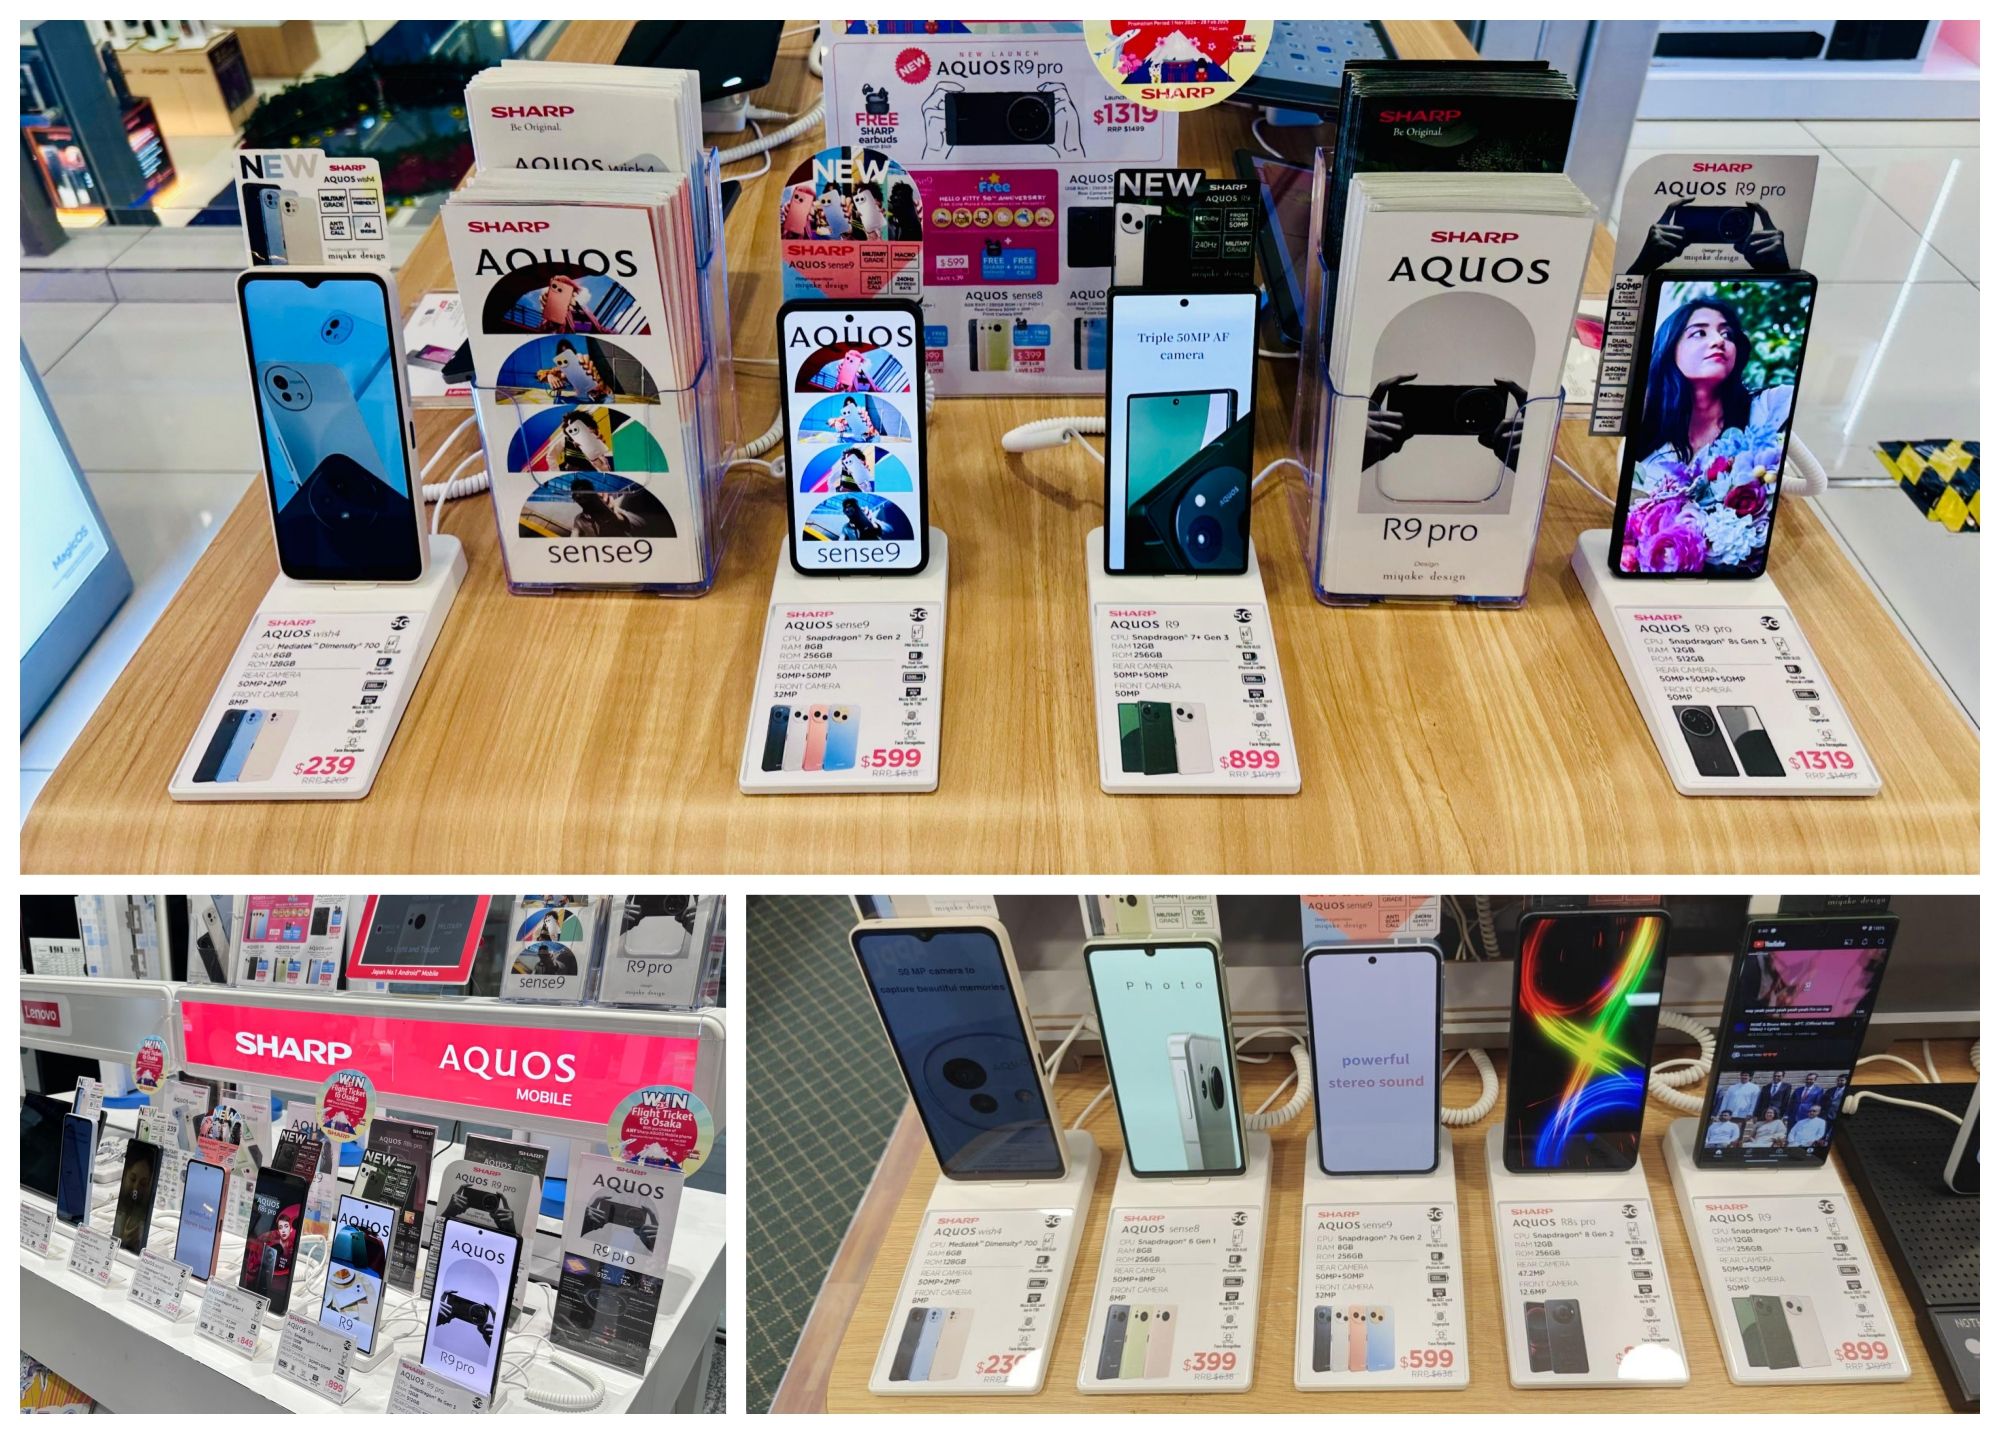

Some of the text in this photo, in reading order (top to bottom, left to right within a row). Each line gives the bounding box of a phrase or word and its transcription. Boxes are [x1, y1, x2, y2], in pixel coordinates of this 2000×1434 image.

[901, 55, 926, 77] NEW
[937, 60, 1063, 78] AQUOS R9 pro
[1141, 87, 1215, 99] SHARP
[491, 106, 574, 118] SHARP
[1379, 110, 1462, 123] SHARP
[856, 112, 899, 126] FREE
[511, 123, 561, 133] Be Original.
[1393, 128, 1443, 138] Be Original.
[859, 136, 897, 144] earbuds
[240, 154, 318, 179] NEW
[813, 159, 889, 184] NEW
[1693, 163, 1753, 173] SHARP
[324, 176, 355, 184] AQUOS
[1119, 173, 1201, 197] NEW
[978, 182, 1011, 193] Free
[1654, 181, 1786, 199] AQUOS R9 pro
[1206, 195, 1237, 203] AQUOS
[468, 222, 549, 233] SHARP
[1430, 232, 1518, 243] SHARP
[788, 246, 854, 256] SHARP
[476, 248, 637, 277] AQUOS
[789, 261, 854, 269] AQUOS sense9
[1388, 256, 1550, 287] AQUOS
[966, 292, 1043, 301] AQUOS sense8
[790, 325, 913, 347] AQUOS
[1138, 332, 1229, 344] Triple 50MP AF
[1161, 351, 1204, 360] camera
[1384, 518, 1477, 547] R9 pro
[52, 525, 88, 570] MagicOS
[548, 539, 652, 564] sense9
[818, 543, 900, 563] sense9
[785, 621, 833, 631] AQUOS
[1111, 621, 1160, 630] AQUOS
[1640, 624, 1690, 634] AQUOS
[1714, 626, 1731, 634] pro
[262, 629, 340, 639] AQUOS wish4
[861, 748, 921, 768] $599
[1220, 750, 1280, 769] $899
[1789, 751, 1854, 770] $1319
[293, 757, 355, 775] $239
[1347, 902, 1372, 910] sense9
[1765, 940, 1786, 948] YouTube
[627, 961, 672, 976] R9 pro
[520, 976, 565, 989] sense9
[1126, 981, 1202, 990] Photo
[880, 984, 1005, 994] capture beautiful memories
[24, 1006, 56, 1021] Lenovo
[235, 1032, 576, 1083] SHARP AQUOS
[1342, 1054, 1409, 1068] powerful
[1329, 1076, 1424, 1088] stereo sound
[342, 1093, 358, 1102] Osaka
[349, 1087, 366, 1097] Ticket
[516, 1088, 572, 1106] MOBILE
[642, 1091, 689, 1109] WIN
[213, 1110, 237, 1120] NEW
[632, 1107, 692, 1121] Flight Ticket
[652, 1119, 681, 1129] Osaka
[281, 1131, 307, 1144] NEW
[379, 1136, 401, 1145] AQUOS
[364, 1150, 396, 1167] NEW
[519, 1151, 544, 1159] SHARP
[473, 1166, 501, 1176] SHARP
[616, 1166, 646, 1176] SHARP
[456, 1173, 516, 1193] AQUOS R9 pro
[592, 1174, 665, 1199] AQUOS
[267, 1207, 276, 1215] pro
[1513, 1219, 1595, 1228] AQUOS pro
[1709, 1214, 1753, 1223] AQUOS
[339, 1213, 390, 1237] AQUOS
[1122, 1225, 1165, 1234] AQUOS
[1318, 1221, 1392, 1231] AQUOS sense9
[934, 1228, 976, 1237] AQUOS
[451, 1239, 505, 1265] AQUOS
[339, 1316, 353, 1330] R9
[1835, 1341, 1889, 1361] $899
[440, 1351, 475, 1375] R9 pro
[1183, 1352, 1236, 1371] $399
[1400, 1350, 1453, 1369] $599
[400, 1370, 424, 1385] AQUOS
